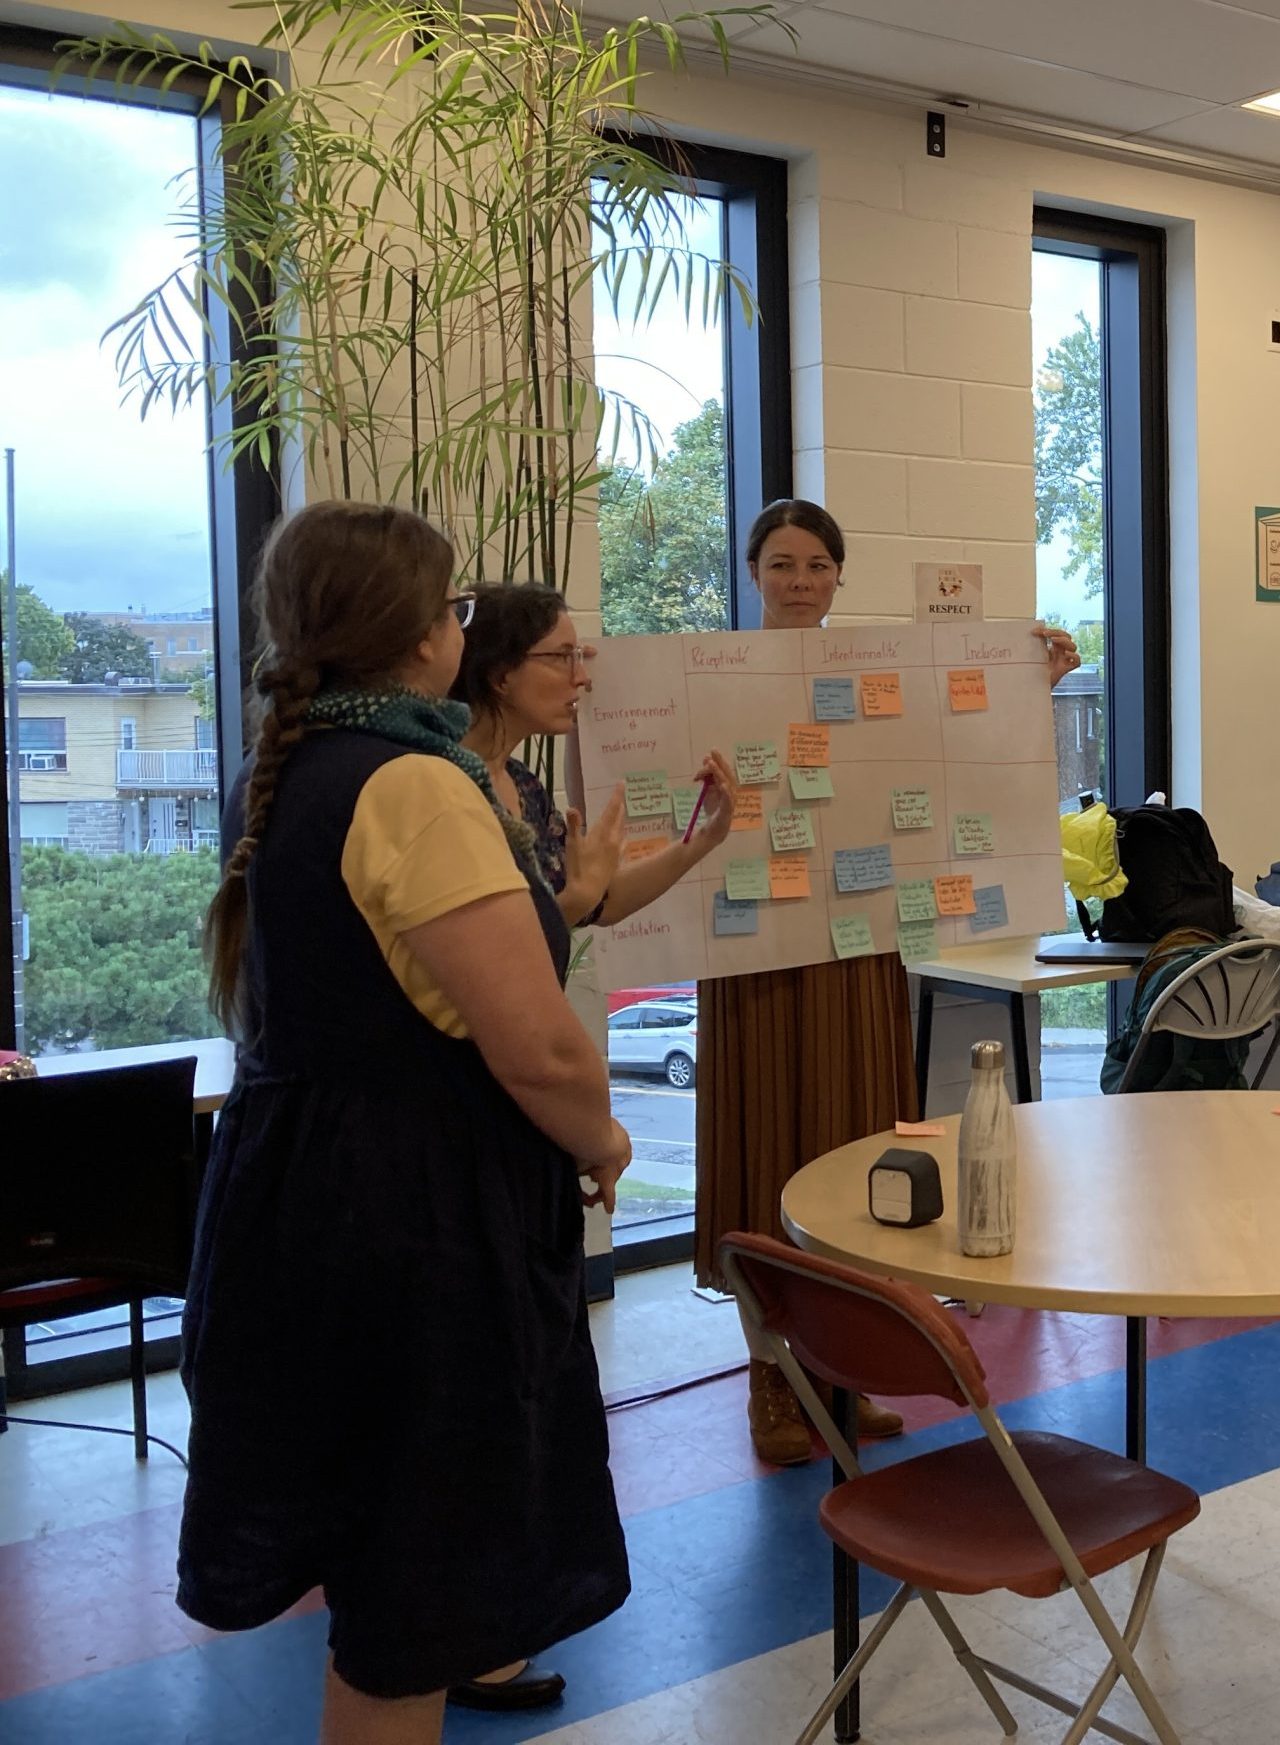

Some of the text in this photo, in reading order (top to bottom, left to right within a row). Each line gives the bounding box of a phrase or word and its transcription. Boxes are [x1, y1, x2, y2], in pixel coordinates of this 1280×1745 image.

[928, 604, 972, 614] RESPECT
[960, 633, 1012, 660] Inclusion
[593, 698, 677, 721] Environnement
